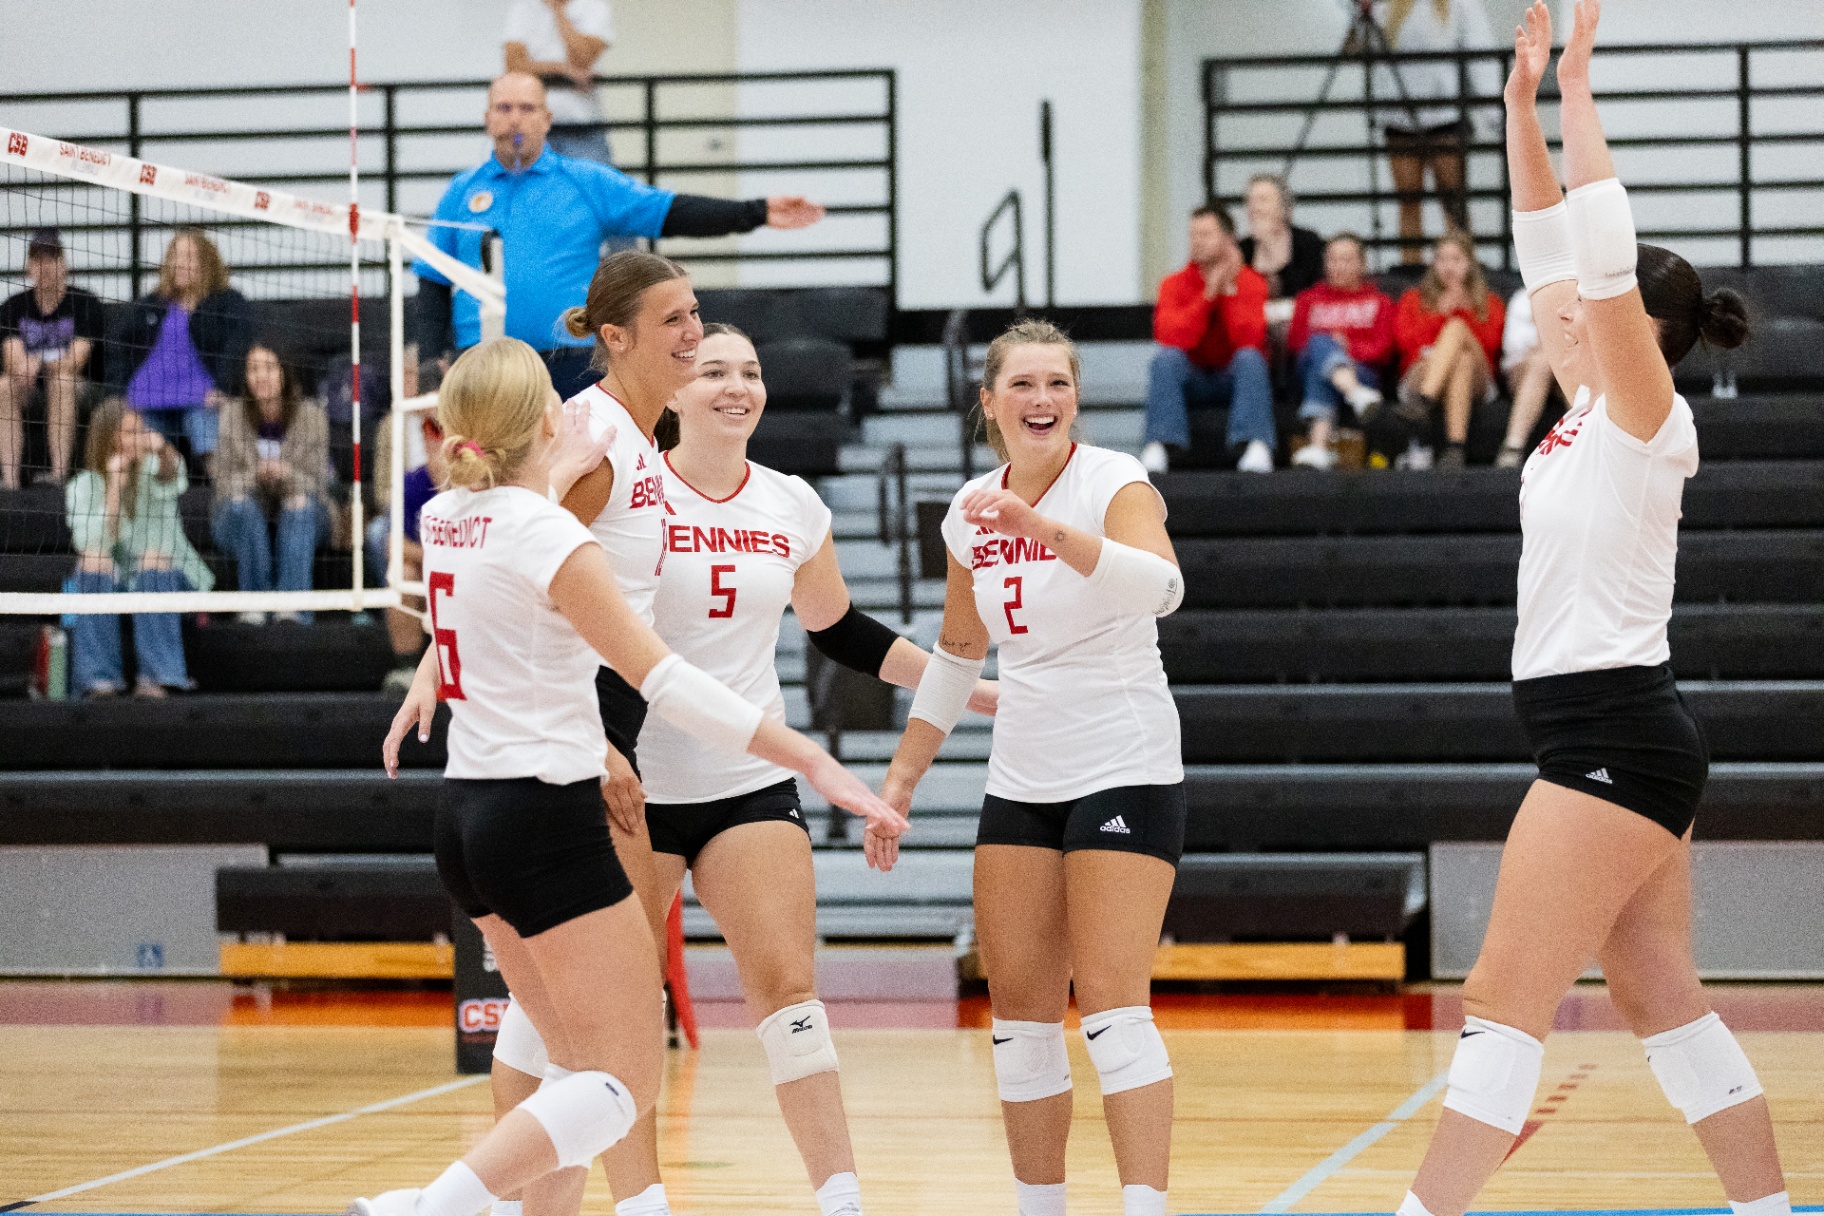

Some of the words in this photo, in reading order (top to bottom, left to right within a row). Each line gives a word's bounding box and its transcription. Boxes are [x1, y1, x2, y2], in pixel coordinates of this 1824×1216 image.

[8, 132, 28, 157] CSB
[668, 525, 790, 559] ENNIES
[971, 537, 1057, 571] BENNIE
[708, 564, 737, 618] 5
[1003, 576, 1029, 634] 2
[428, 571, 468, 701] 6
[1100, 825, 1131, 834] adidas
